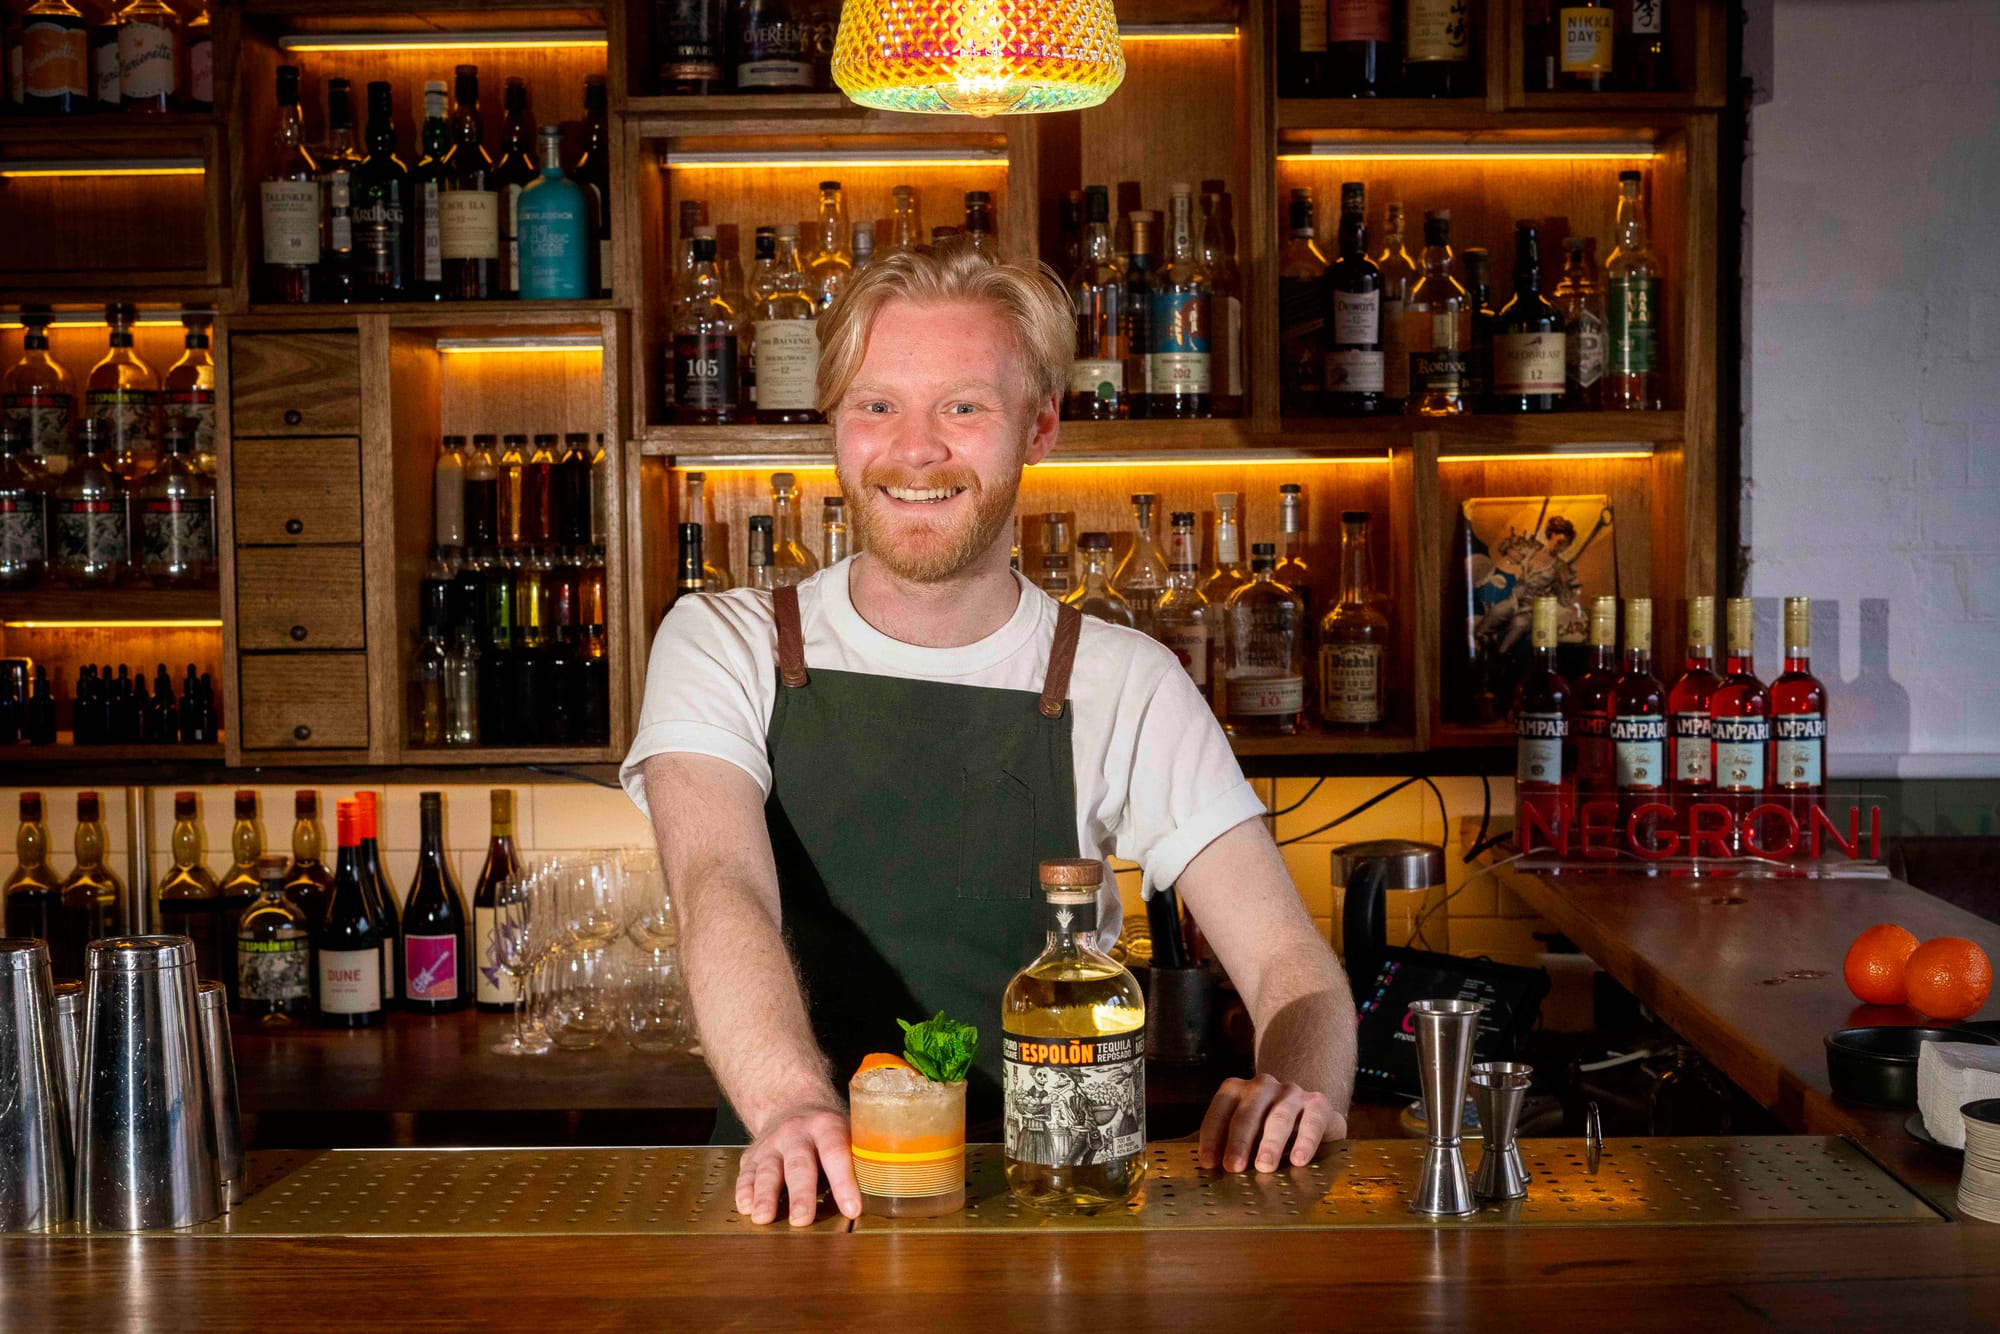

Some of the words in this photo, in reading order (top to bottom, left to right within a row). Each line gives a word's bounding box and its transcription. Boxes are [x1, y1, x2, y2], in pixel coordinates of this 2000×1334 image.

[1568, 16, 1611, 28] NIKKA
[1568, 31, 1601, 42] DAYS
[264, 192, 314, 202] TALISKER
[686, 358, 719, 377] 105
[780, 366, 790, 374] 12
[1530, 370, 1543, 381] 12
[1260, 695, 1281, 707] 10
[1610, 722, 1668, 739] CAMPARI
[1522, 801, 1881, 860] NEGRONI
[327, 969, 361, 982] DUNE
[1096, 1038, 1131, 1054] TEQUILA
[1097, 1050, 1131, 1063] REPOSADO
